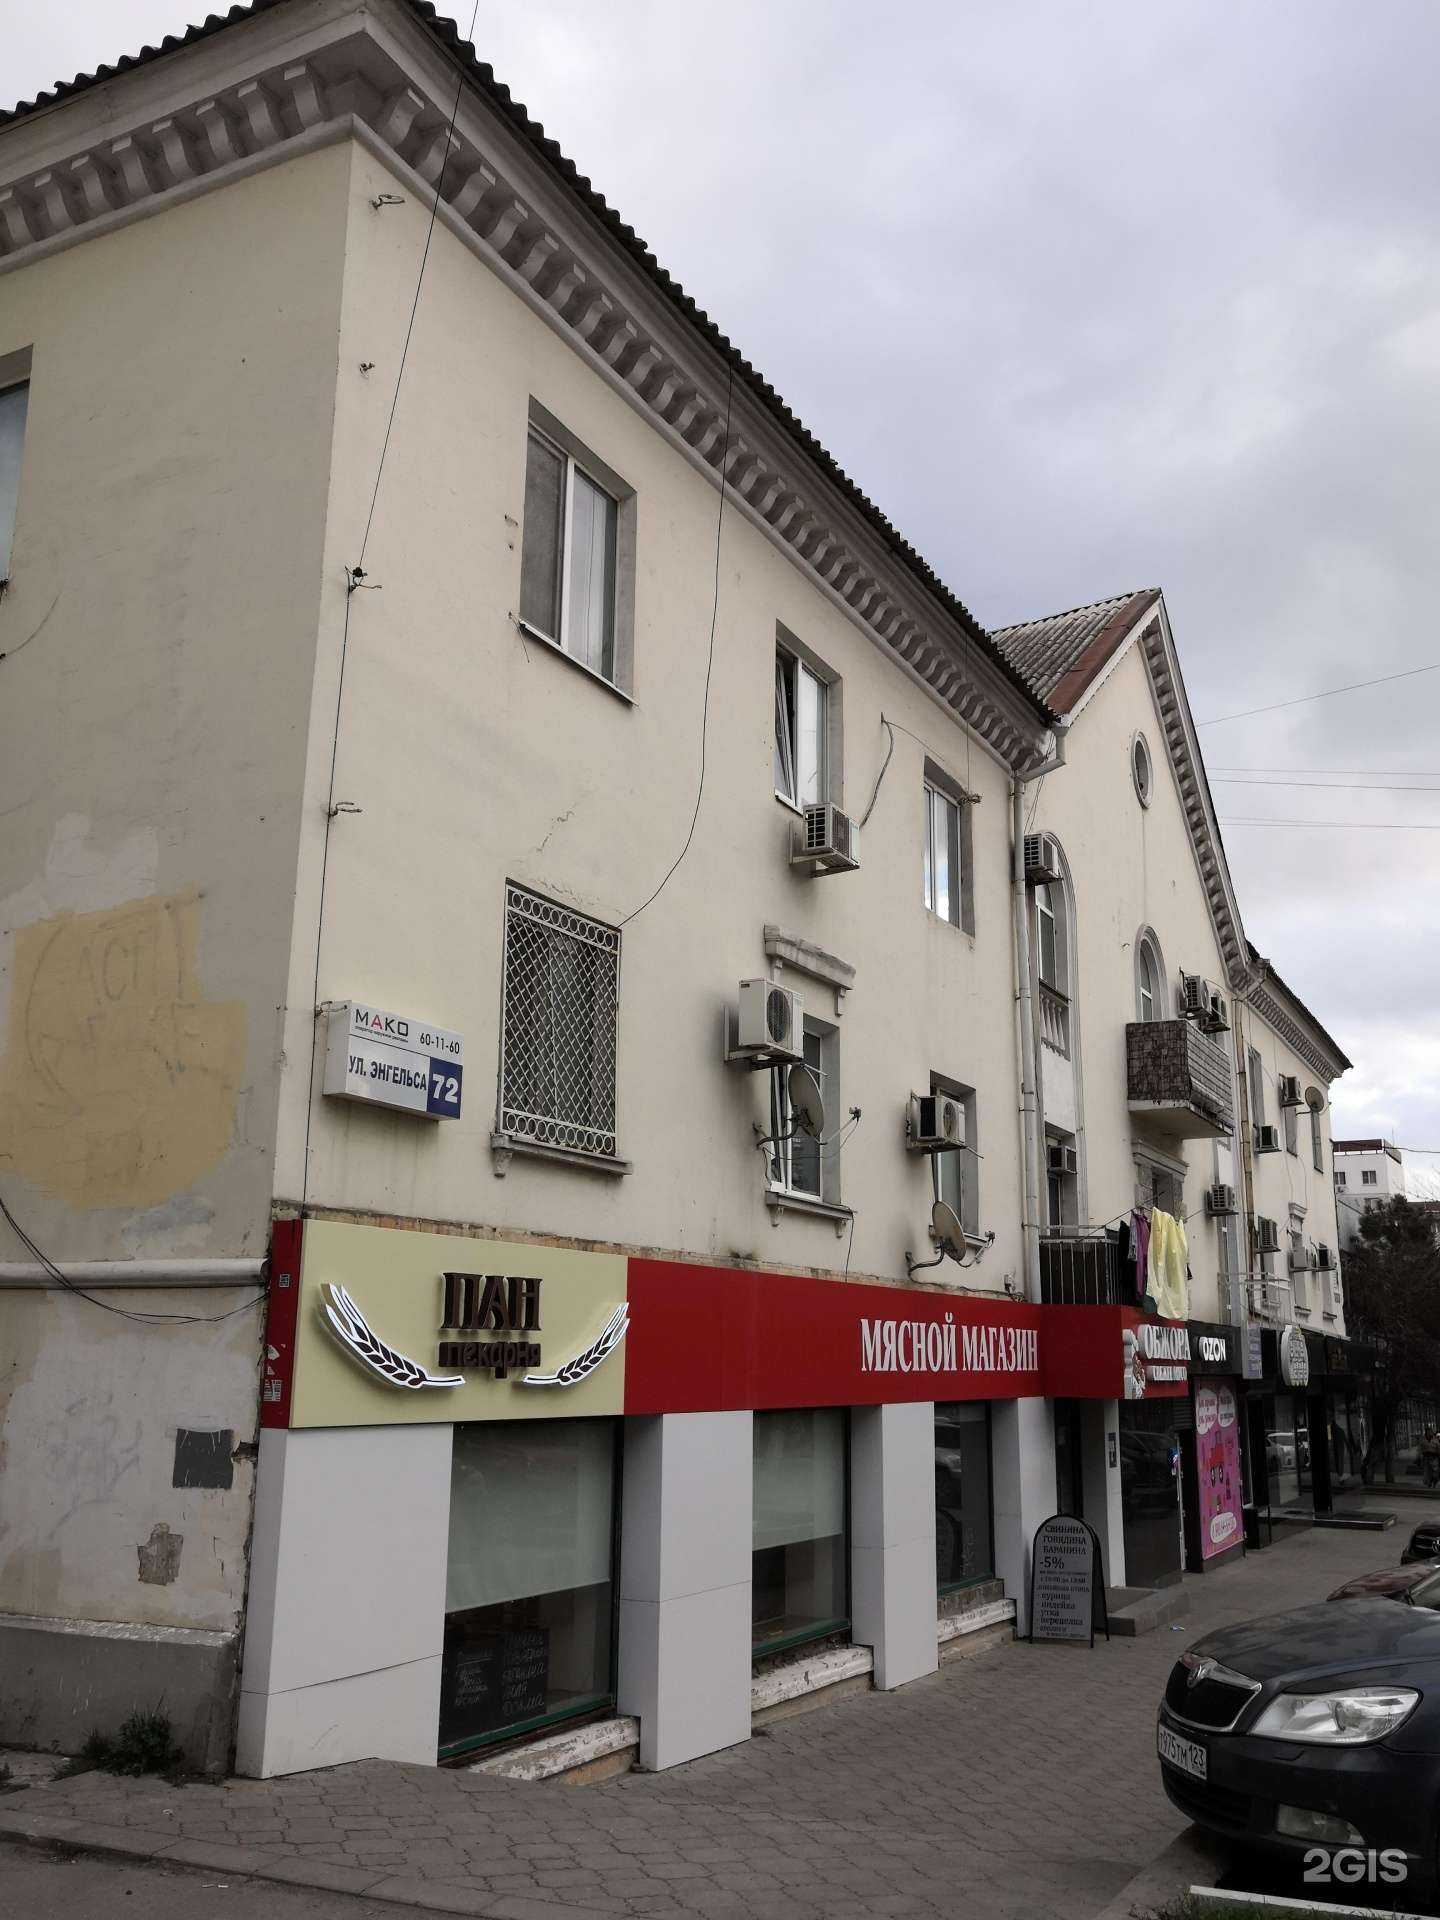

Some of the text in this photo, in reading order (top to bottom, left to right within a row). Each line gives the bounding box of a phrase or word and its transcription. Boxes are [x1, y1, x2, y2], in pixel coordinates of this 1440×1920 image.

[419, 1032, 461, 1055] 60-11-60
[349, 1055, 427, 1091] УЛ. ЭНГЕЛЬСА
[432, 1073, 459, 1104] 72
[440, 1272, 544, 1331] ПАН
[439, 1341, 541, 1379] пекарня
[860, 1311, 1039, 1373] МЯСНОЙ МАГАЗИН
[1142, 1324, 1191, 1361] ОБЖОРА
[1201, 1336, 1226, 1362] OZON
[1040, 1556, 1065, 1569] -5%
